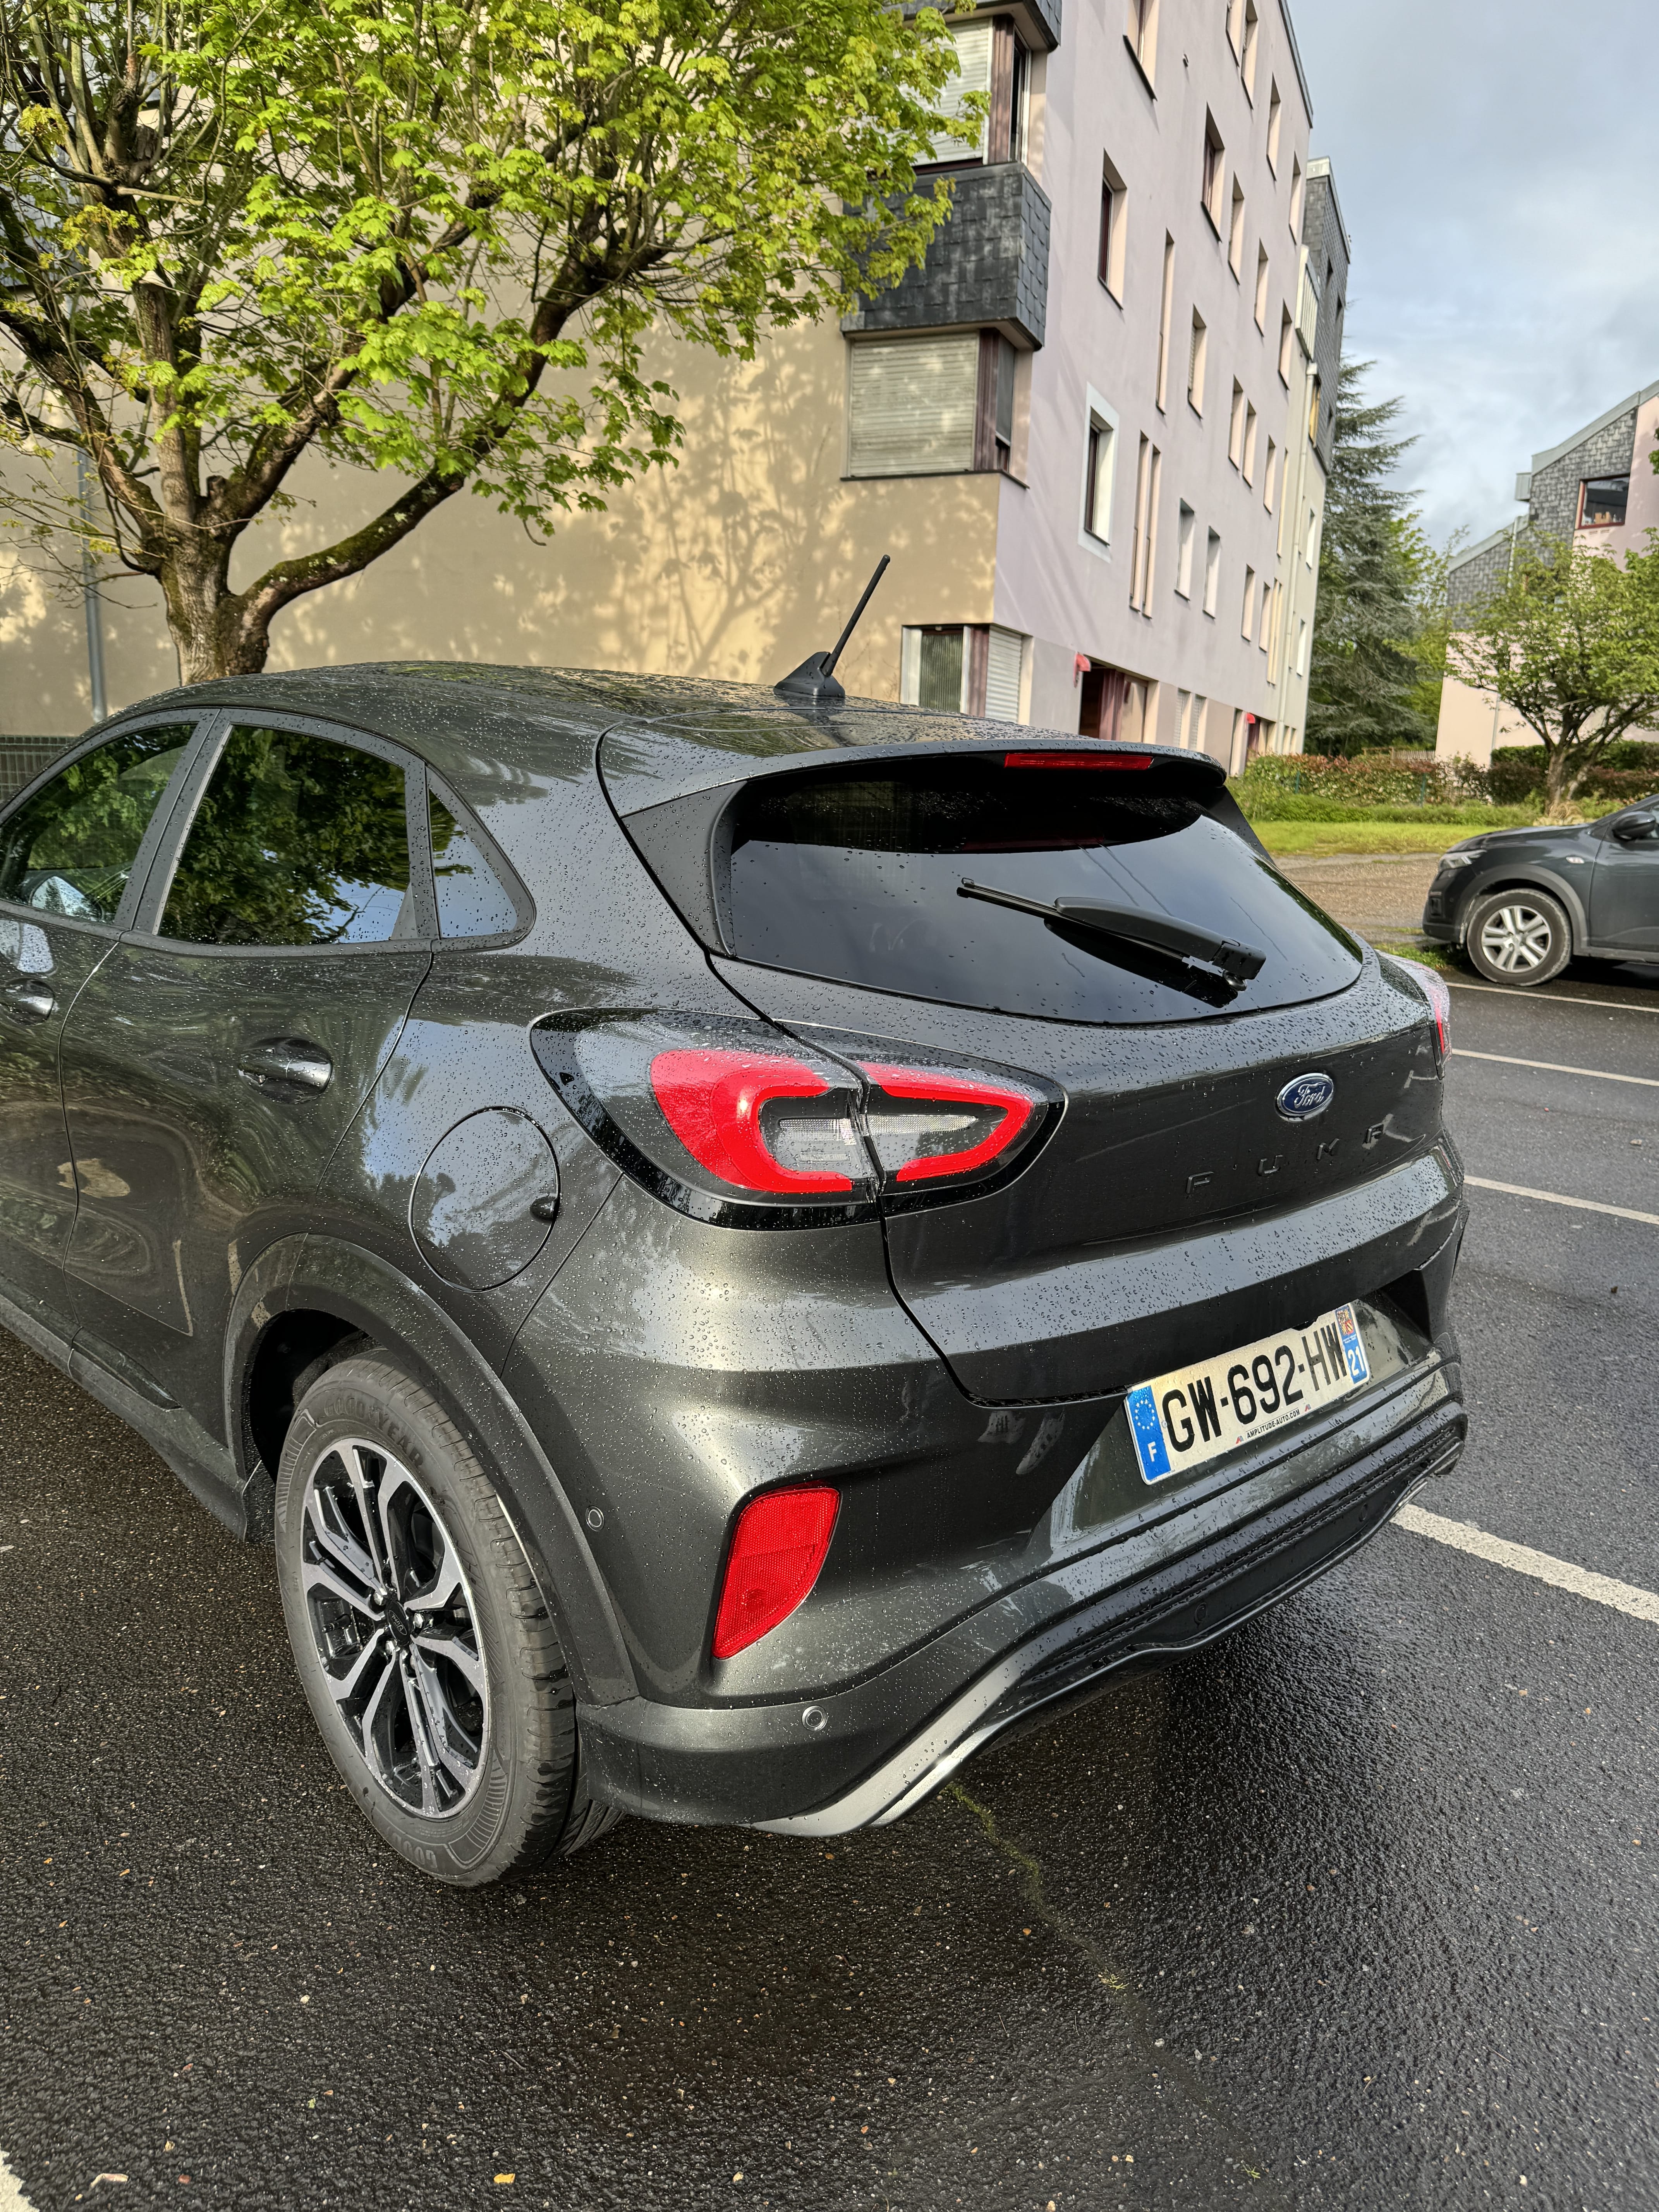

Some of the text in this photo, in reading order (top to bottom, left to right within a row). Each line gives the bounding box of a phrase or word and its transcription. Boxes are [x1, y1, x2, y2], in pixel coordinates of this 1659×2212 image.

[1294, 1082, 1326, 1109] Ford
[1348, 1346, 1365, 1376] 21
[1162, 1321, 1347, 1452] GW-692-HW
[1247, 1408, 1300, 1439] AMPLITUDE-AUTO.COM
[1147, 1441, 1157, 1462] F
